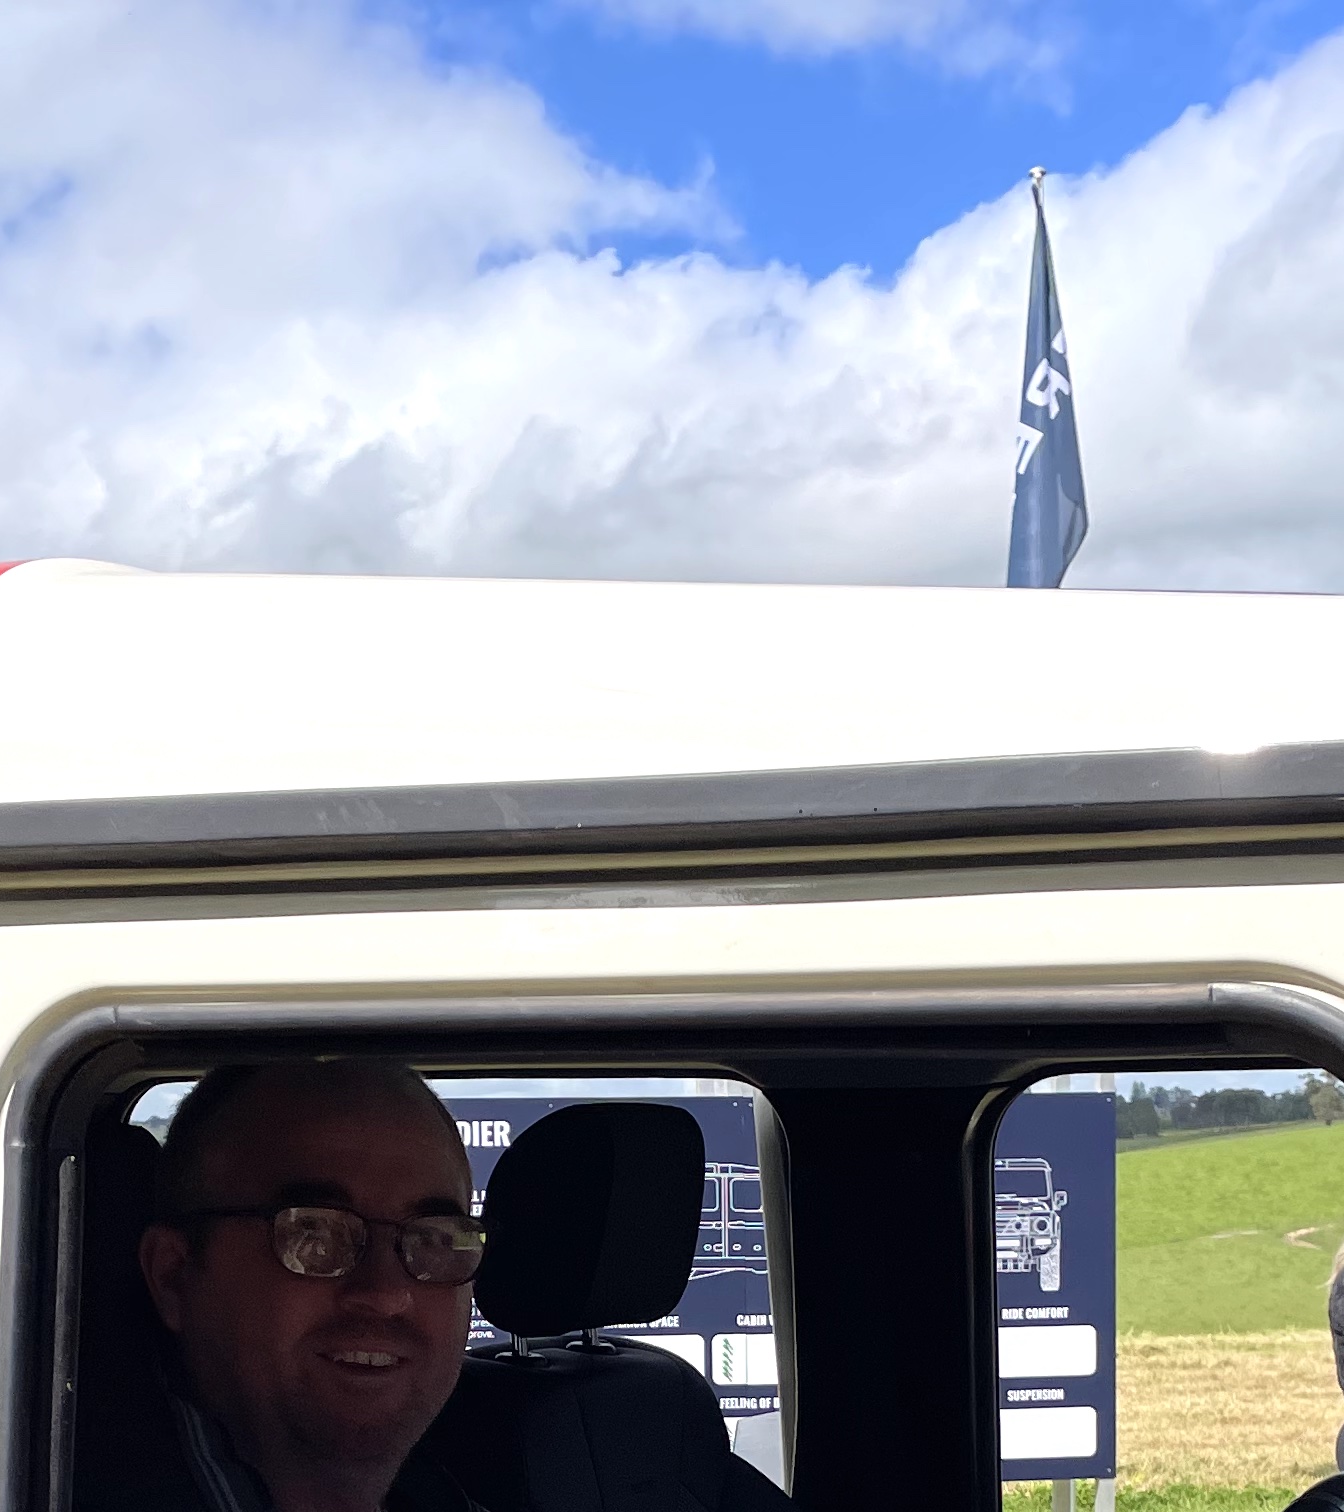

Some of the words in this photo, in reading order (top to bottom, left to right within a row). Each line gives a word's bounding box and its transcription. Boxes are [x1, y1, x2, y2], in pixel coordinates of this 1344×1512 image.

[1001, 1308, 1024, 1320] RIDE
[1025, 1307, 1070, 1320] COMFORT
[1006, 1389, 1065, 1402] SUSPENSION
[719, 1397, 758, 1410] FEELING
[759, 1397, 772, 1409] OF
